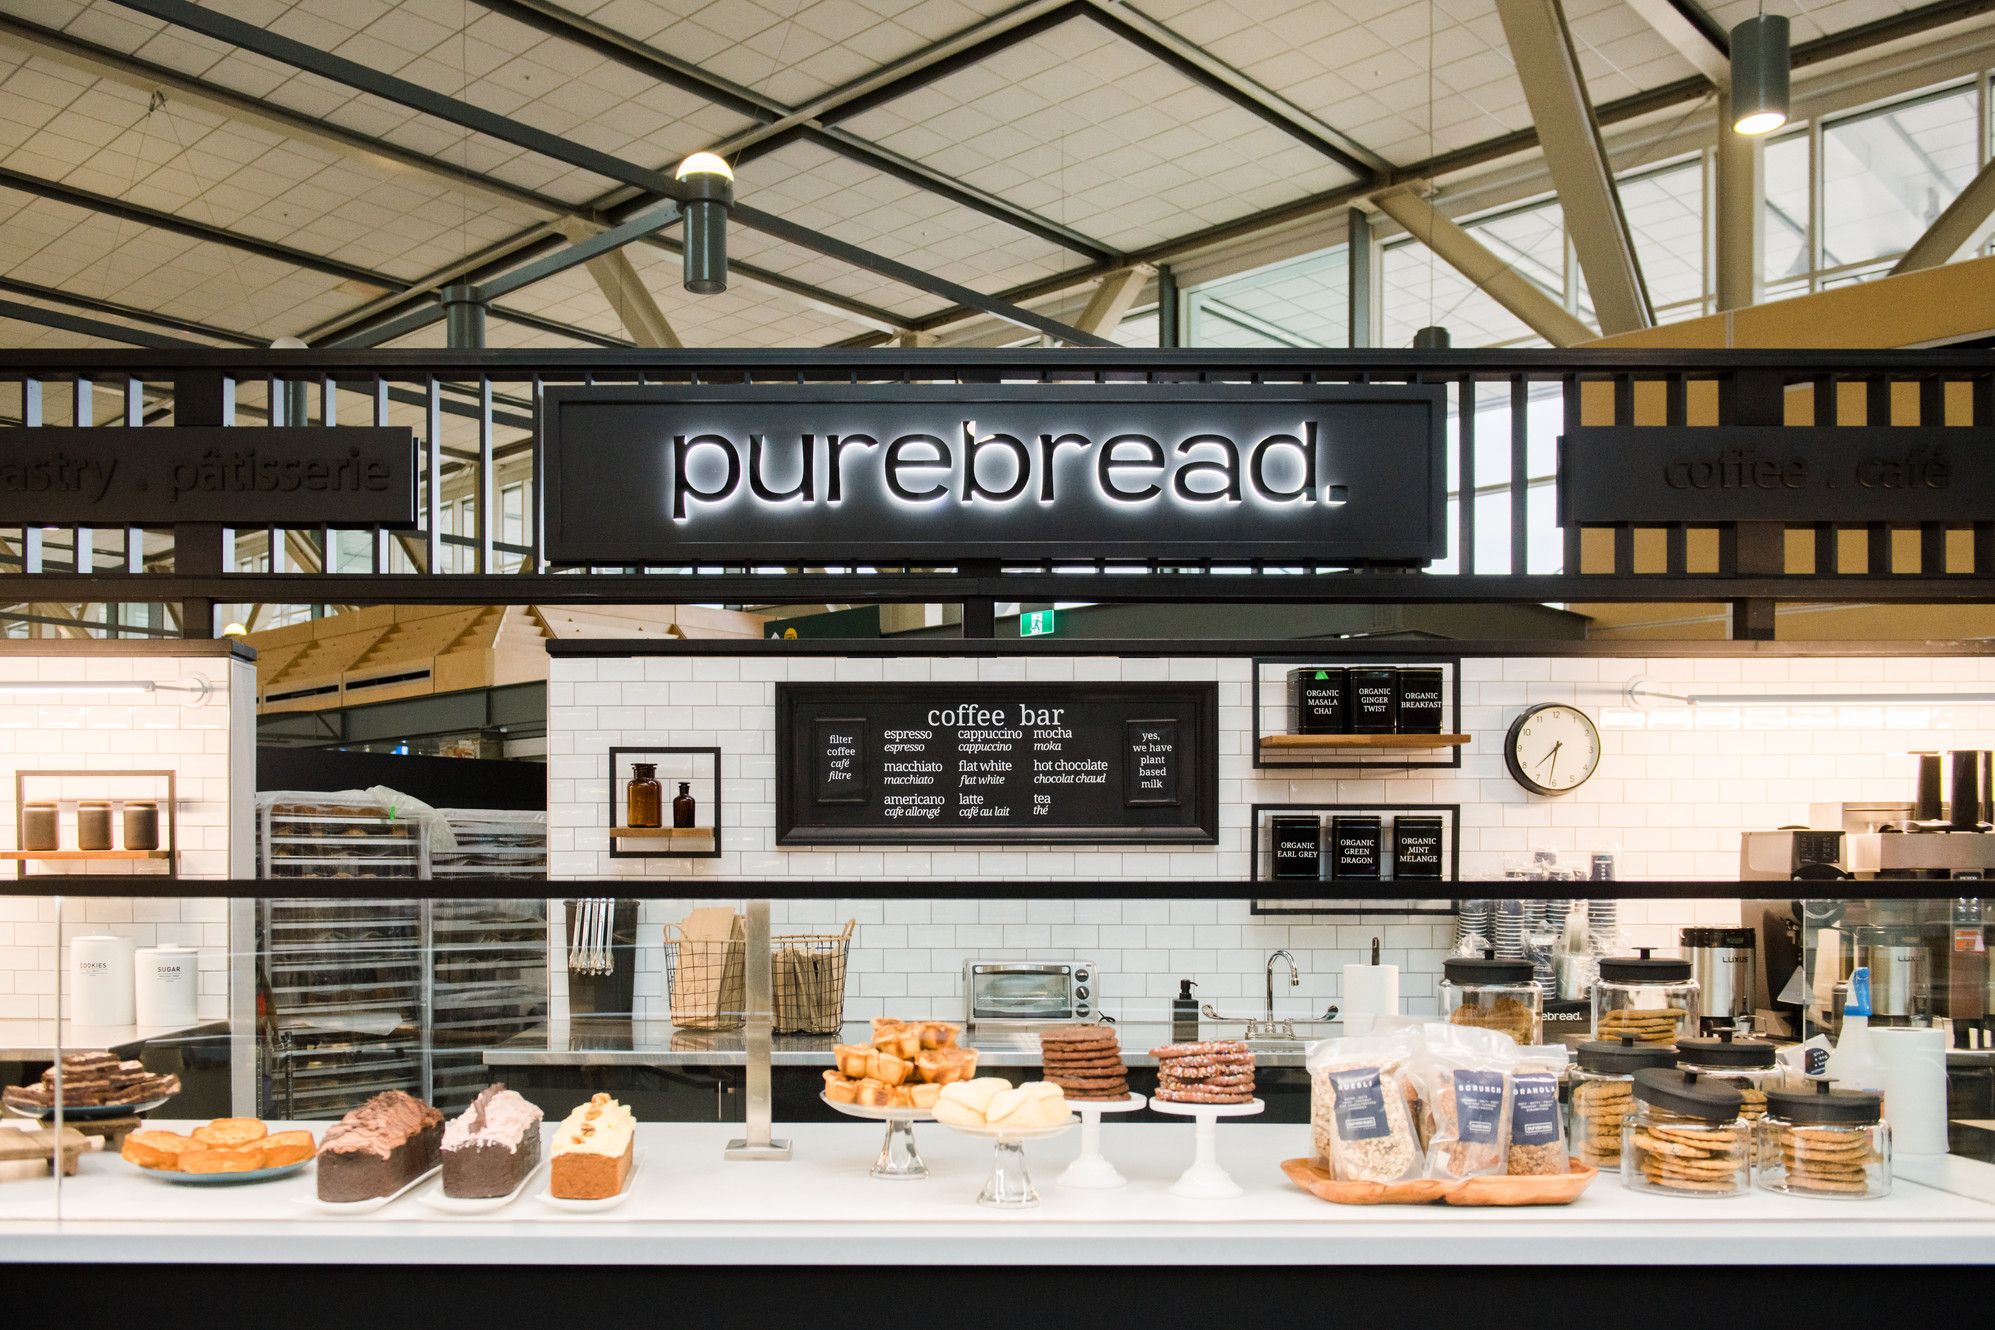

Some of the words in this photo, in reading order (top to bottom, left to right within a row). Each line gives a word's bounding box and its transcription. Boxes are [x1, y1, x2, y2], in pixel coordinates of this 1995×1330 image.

[671, 420, 1349, 521] purebread.
[1663, 449, 1808, 490] coffee
[1856, 445, 1952, 490] café
[169, 446, 391, 504] pâtisserie
[1306, 689, 1340, 697] ORGANIC
[1358, 687, 1391, 695] ORGANIC
[1360, 696, 1389, 704] GINGER
[1404, 692, 1439, 700] ORGANIC
[1307, 698, 1339, 706] MASALA
[1400, 700, 1442, 709] BREAKFAST
[1313, 707, 1332, 715] CHAI
[1363, 705, 1387, 713] TWIST
[928, 704, 1004, 726] coffee
[1019, 704, 1064, 725] bar
[1552, 711, 1560, 719] 12
[884, 730, 932, 742] espresso
[958, 728, 1022, 741] cappuccino
[1034, 727, 1072, 738] mocha
[1522, 728, 1531, 736] 10
[1584, 729, 1590, 737] 2
[830, 735, 852, 743] filter
[1142, 733, 1160, 742] yes,
[884, 744, 925, 754] espresso
[958, 740, 1012, 754] cappuccino
[1034, 741, 1061, 750] moka
[1150, 743, 1172, 751] have
[827, 747, 855, 756] coffee
[831, 759, 849, 769] café
[1034, 760, 1052, 770] hot
[1055, 759, 1108, 770] chocolate
[1141, 755, 1165, 766] plant
[884, 761, 942, 772] macchiato
[959, 760, 980, 771] flat
[979, 760, 1012, 771] white
[1140, 767, 1166, 776] based
[828, 771, 851, 782] filtre
[884, 775, 934, 784] macchiato
[959, 775, 976, 787] flat
[978, 775, 1005, 784] white
[1034, 774, 1074, 783] chocolat
[1076, 773, 1106, 783] chaud
[1535, 774, 1541, 782] 7
[1569, 775, 1575, 783] 5
[1141, 779, 1162, 788] milk
[1551, 779, 1557, 787] 6
[884, 794, 945, 804] americano
[959, 793, 983, 804] latte
[1034, 794, 1051, 803] tea
[885, 806, 904, 819] cafe
[905, 806, 940, 819] allongé
[959, 806, 978, 819] café
[995, 806, 1010, 816] lait
[1034, 805, 1048, 815] thé
[1280, 841, 1315, 850] ORGANIC
[1340, 838, 1375, 847] ORGANIC
[1401, 837, 1437, 845] ORGANIC
[1277, 850, 1297, 858] EARL
[1298, 850, 1318, 858] GREY
[1344, 847, 1370, 856] GREEN
[1407, 846, 1430, 855] MINT
[1340, 856, 1374, 864] DRAGON
[1399, 853, 1438, 863] MELANGE
